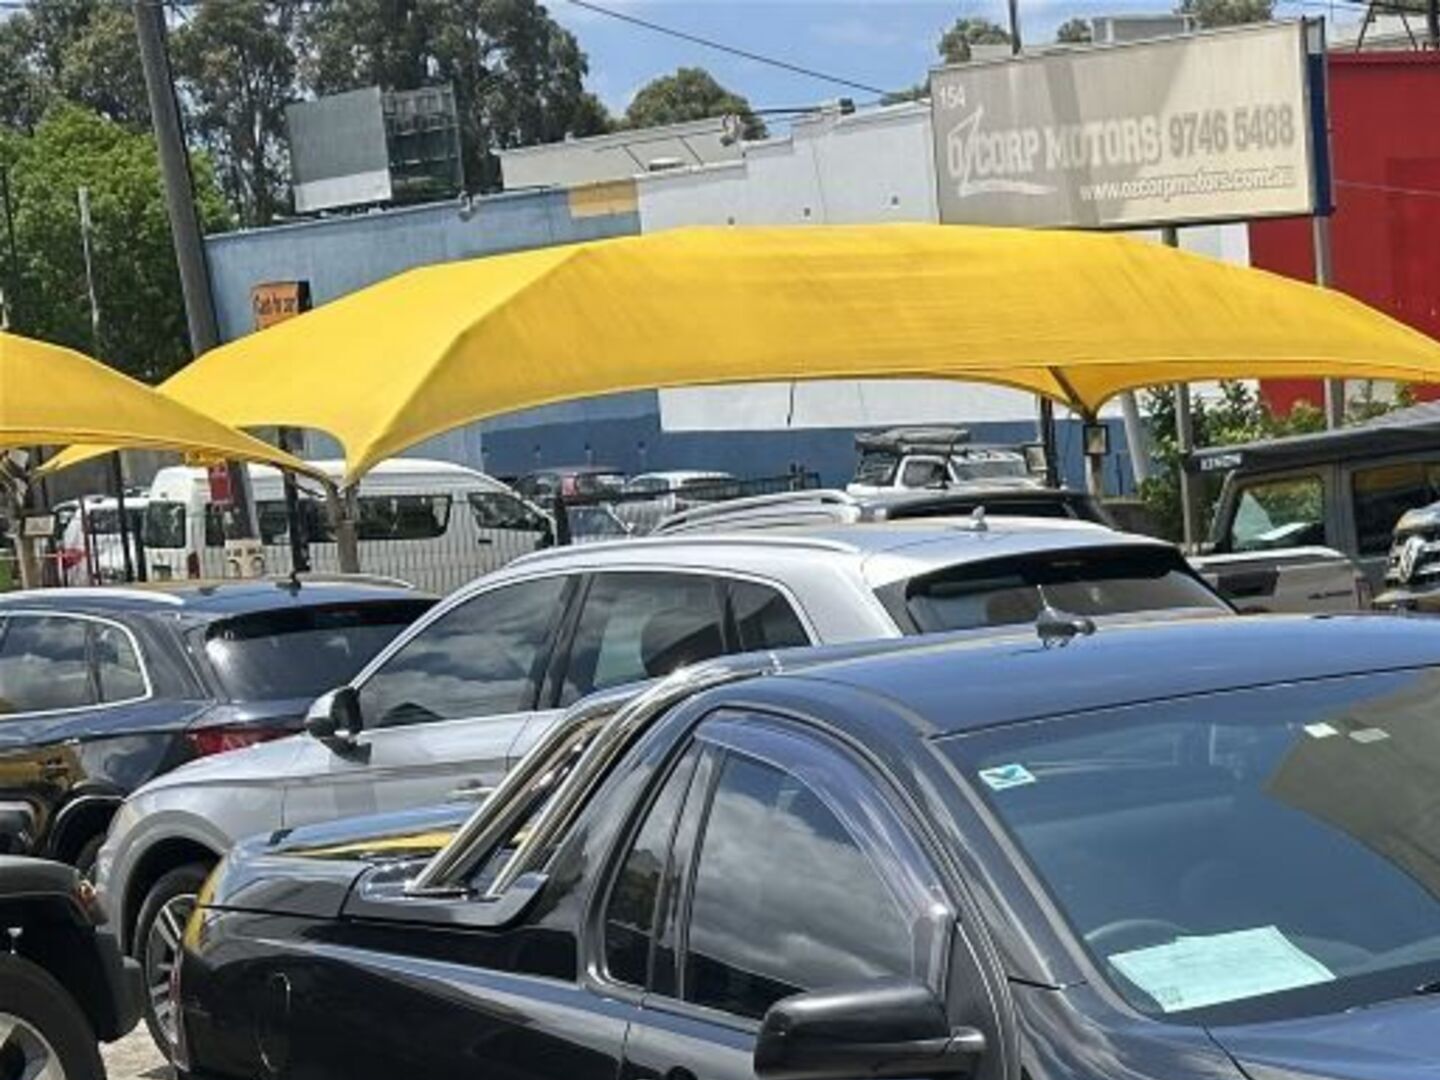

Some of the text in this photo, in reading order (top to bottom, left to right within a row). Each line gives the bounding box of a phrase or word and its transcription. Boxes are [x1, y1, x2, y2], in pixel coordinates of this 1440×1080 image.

[1045, 115, 1162, 170] MOTORS
[1169, 109, 1226, 158] 9746
[1234, 103, 1295, 150] 5488
